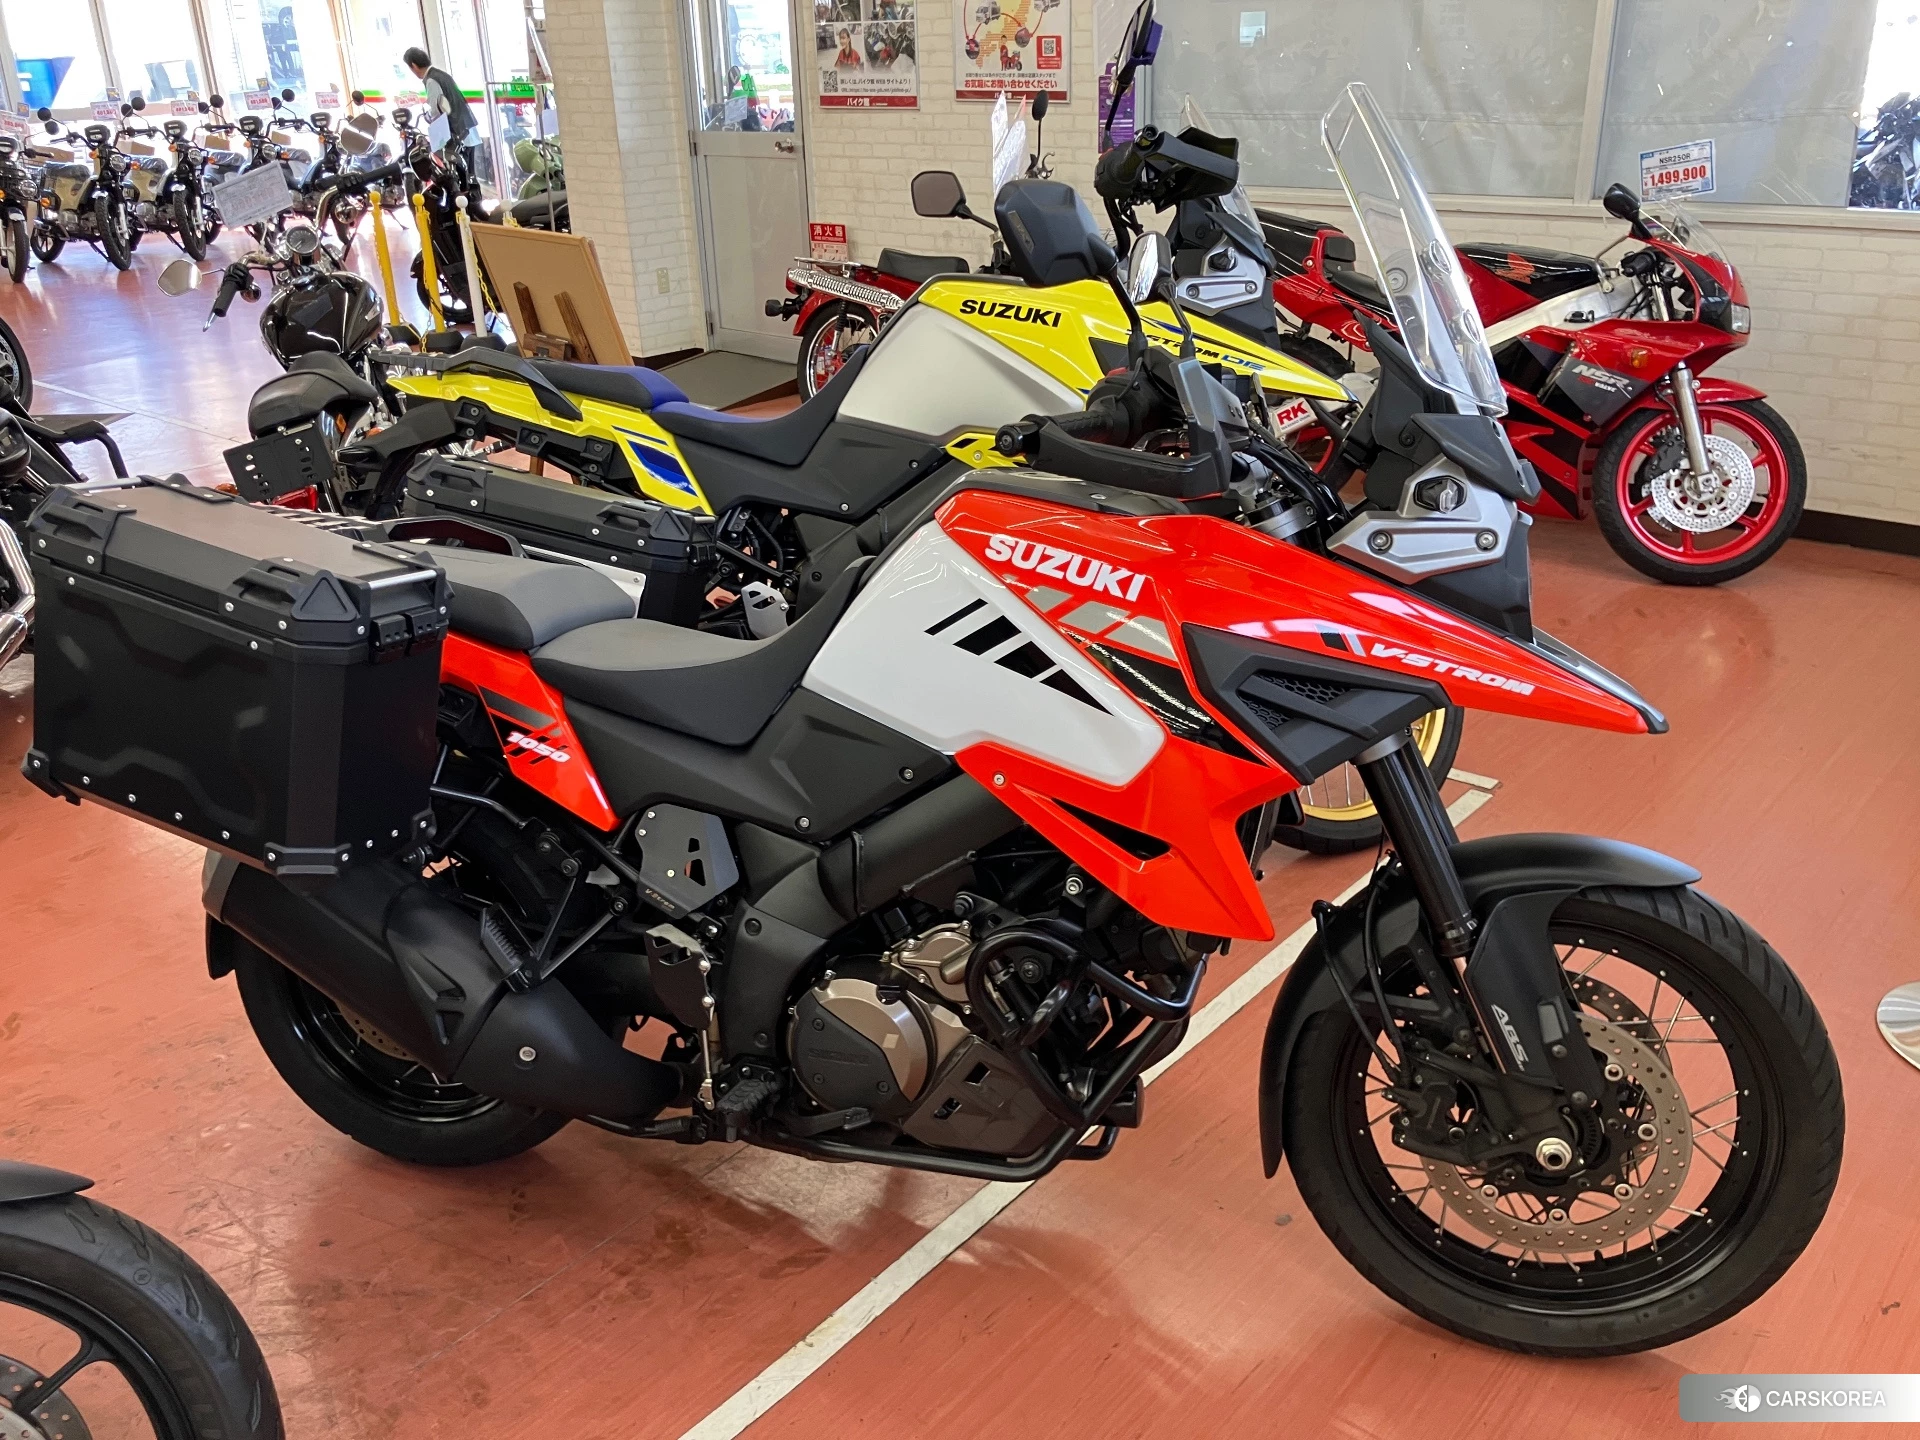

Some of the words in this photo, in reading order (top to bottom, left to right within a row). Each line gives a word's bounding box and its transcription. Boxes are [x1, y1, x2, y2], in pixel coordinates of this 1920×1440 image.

[1659, 153, 1691, 164] NSR250R
[1650, 165, 1707, 187] 1,499,900
[960, 299, 1062, 328] SUZUKI
[1572, 364, 1630, 388] NSR
[1277, 401, 1308, 426] RK
[985, 533, 1147, 603] SUZUKI
[1370, 643, 1536, 696] V-STROM
[507, 731, 571, 763] 1050
[1491, 1004, 1529, 1072] ABS
